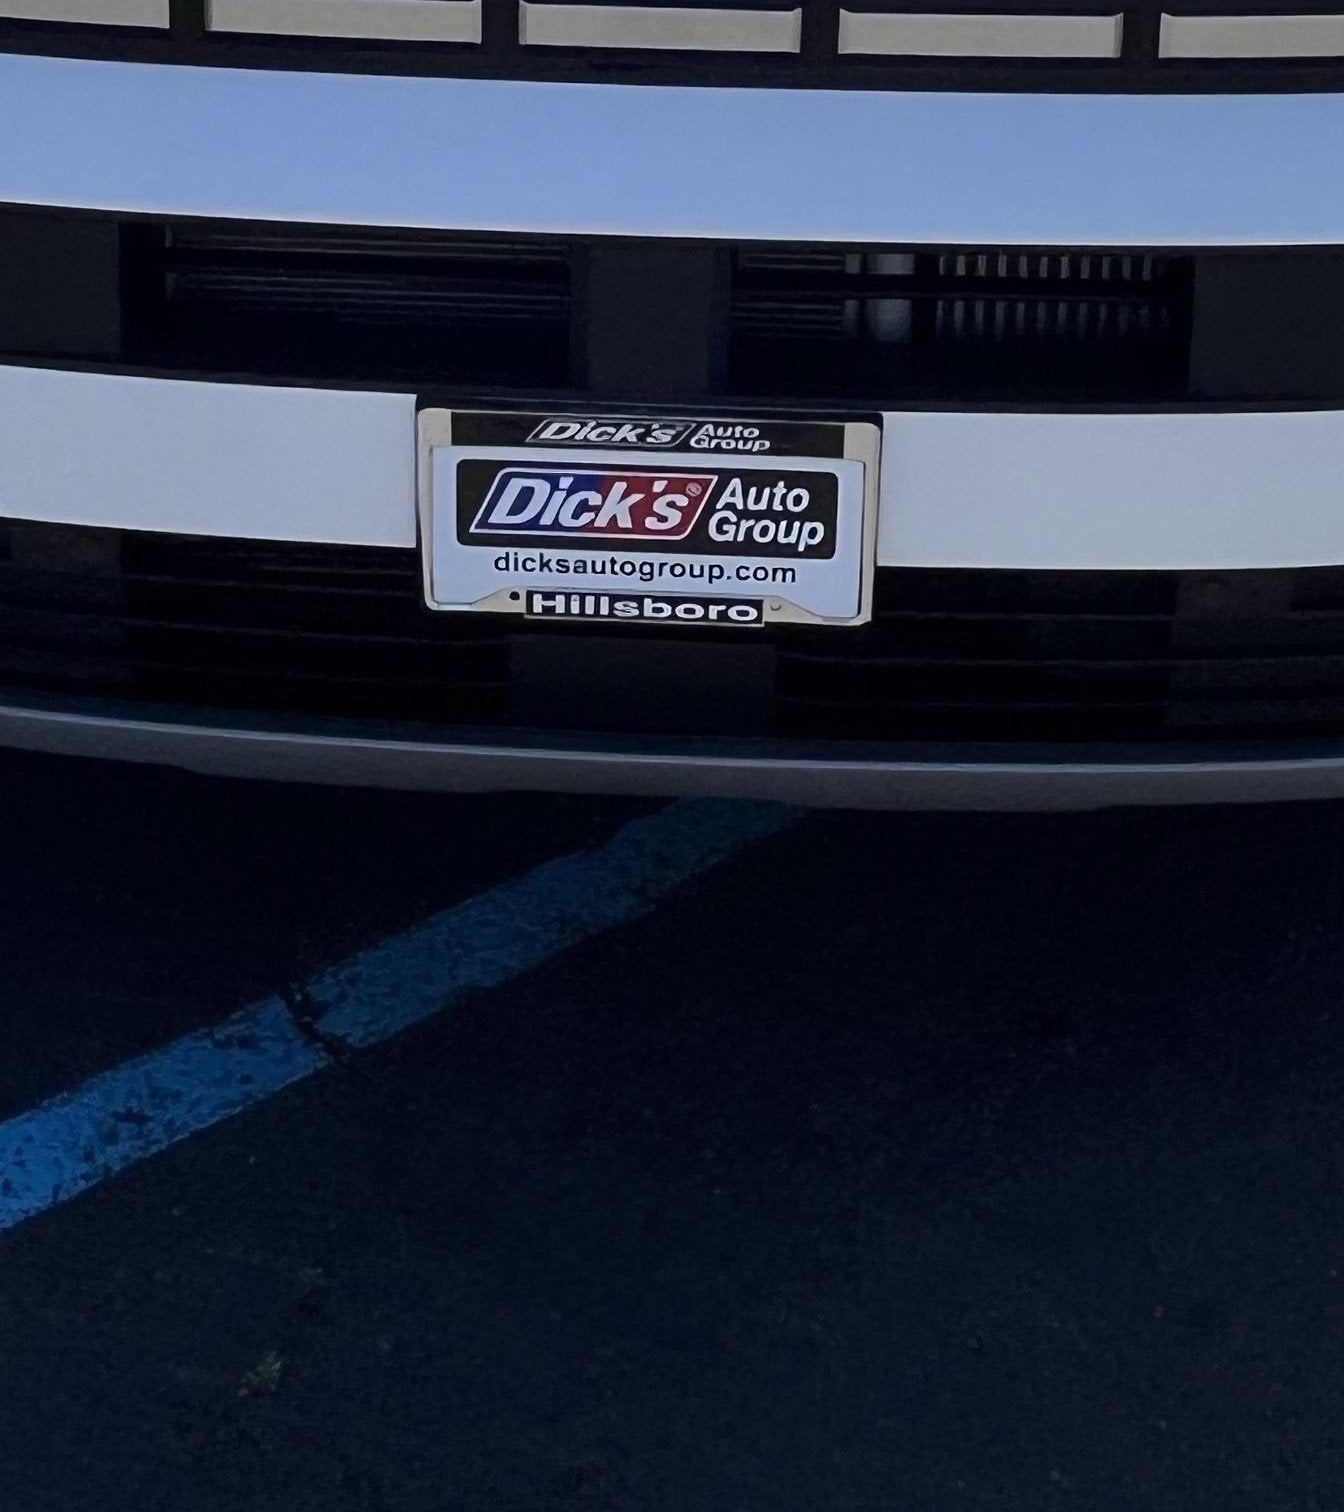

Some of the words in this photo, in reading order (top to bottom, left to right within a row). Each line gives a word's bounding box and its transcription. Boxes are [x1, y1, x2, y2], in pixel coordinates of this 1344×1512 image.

[538, 420, 677, 443] Dick's
[690, 436, 771, 452] Group
[695, 423, 760, 438] Auto
[488, 476, 688, 530] Dick's
[715, 478, 810, 513] Auto
[708, 511, 825, 552] Group
[493, 551, 797, 584] dicksautogroup.com
[531, 593, 759, 622] Hillsboro
